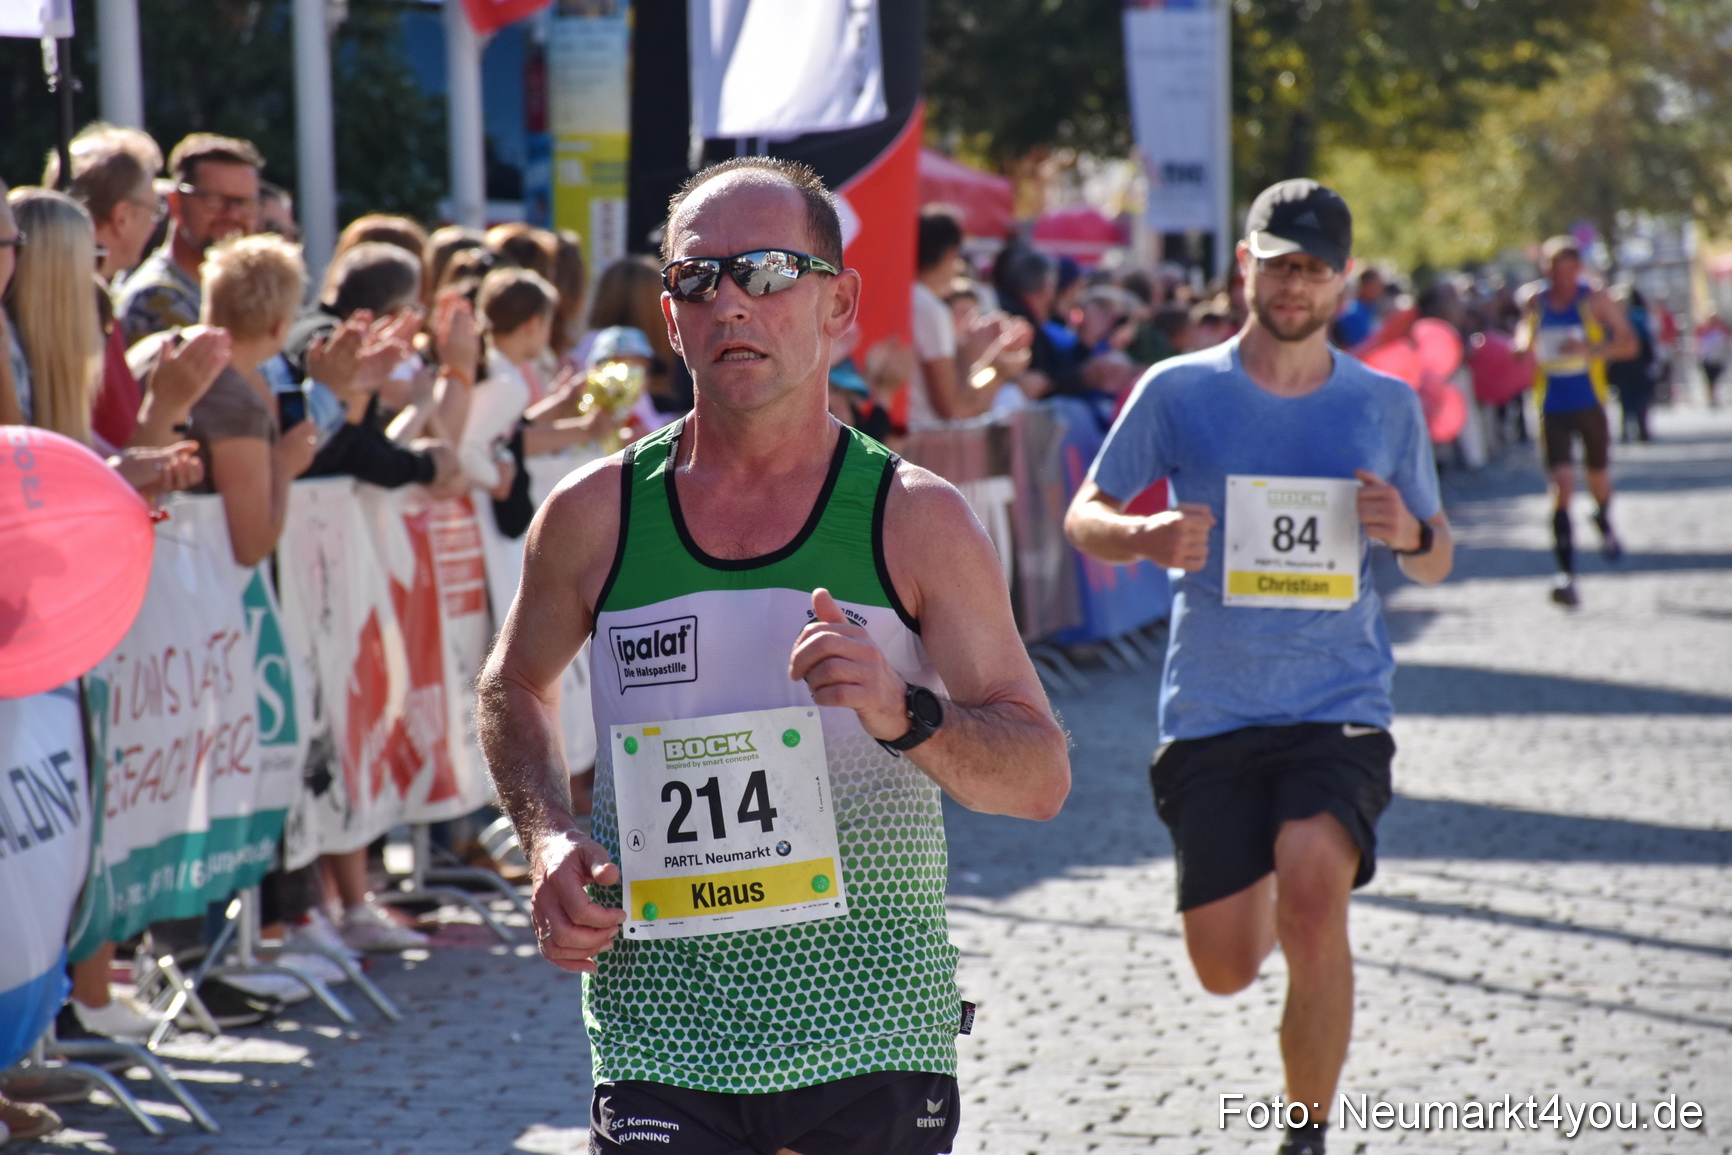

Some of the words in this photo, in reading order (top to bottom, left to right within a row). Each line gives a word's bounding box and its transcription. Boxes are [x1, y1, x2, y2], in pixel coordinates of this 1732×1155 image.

[1272, 515, 1321, 553] 84
[1257, 576, 1329, 594] Christian
[624, 668, 635, 678] Die
[636, 662, 687, 677] Halspastille
[664, 730, 757, 761] BOCK
[666, 762, 691, 770] inspired
[702, 758, 723, 766] smart
[725, 753, 759, 764] concepts
[661, 769, 778, 844] 214
[664, 854, 703, 869] PARTL
[705, 847, 772, 866] Neumarkt
[691, 881, 765, 910] Klaus
[611, 1119, 625, 1131] SC
[627, 1117, 680, 1131] Kemmern
[618, 1132, 670, 1143] RUNNING
